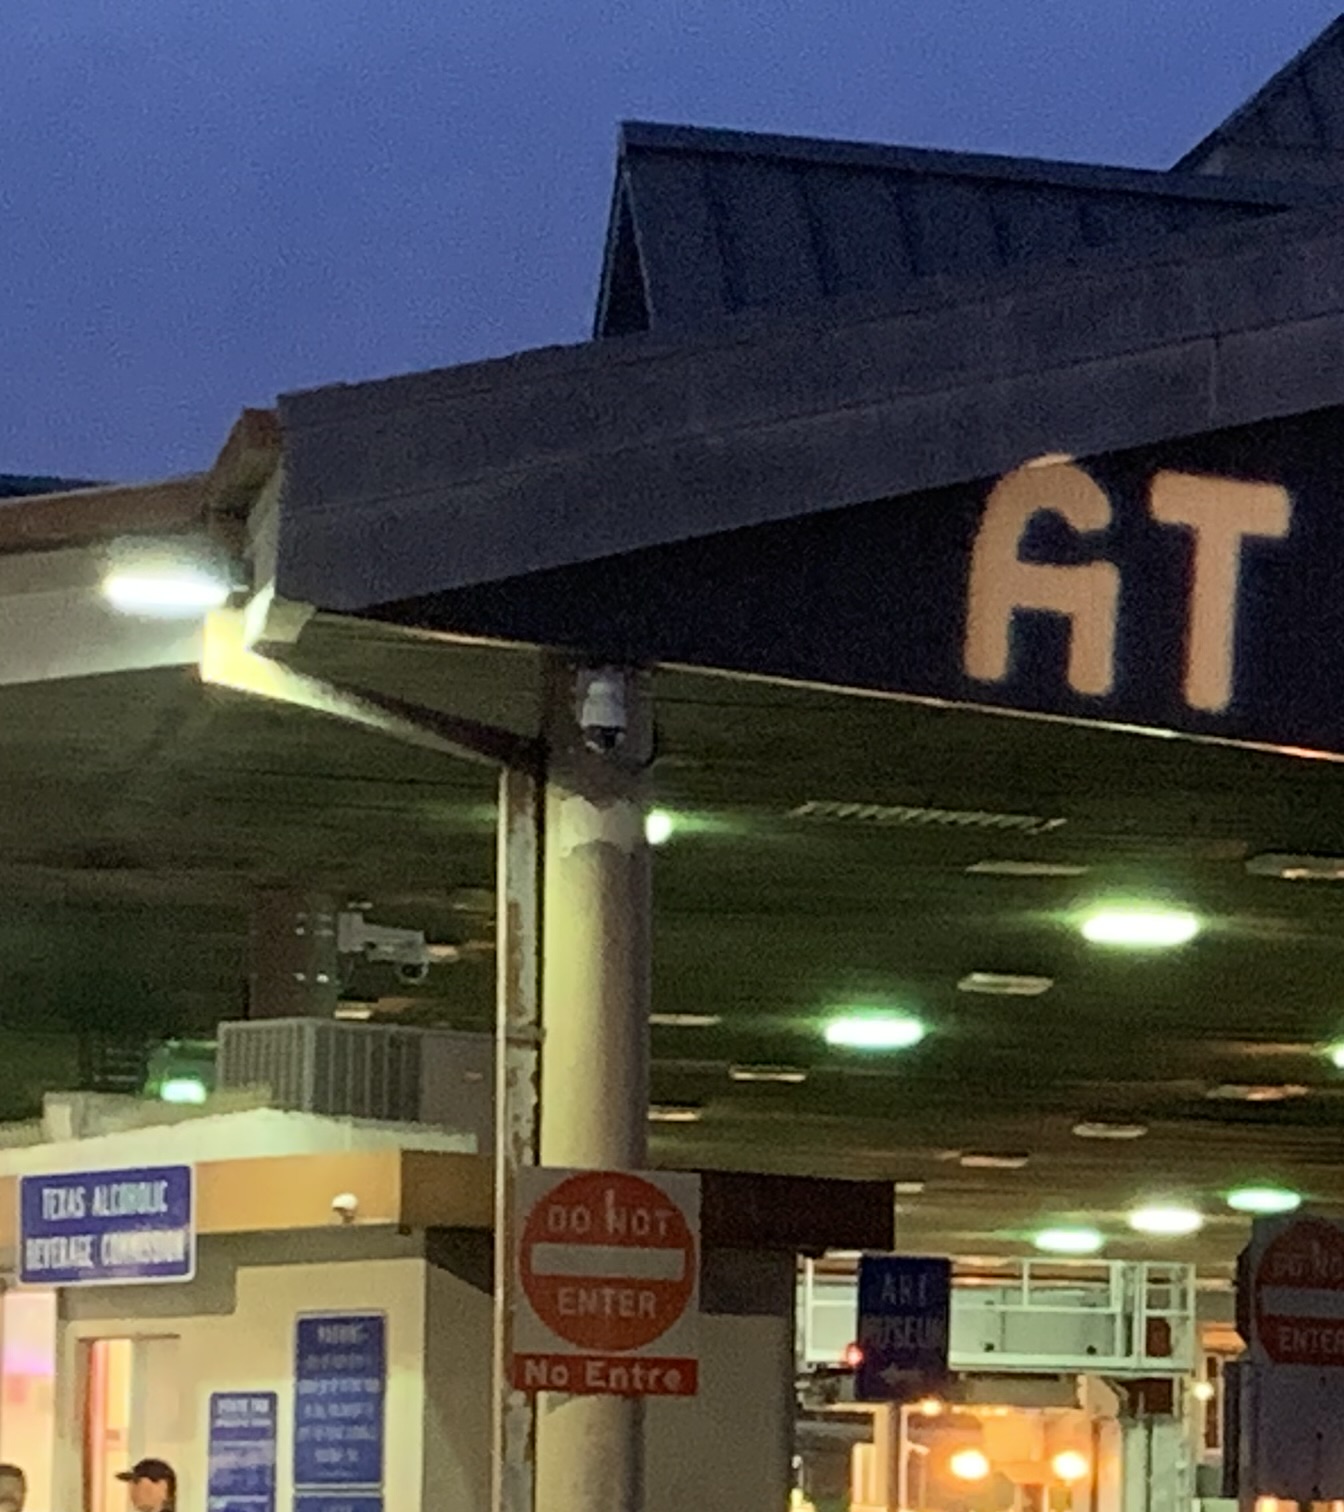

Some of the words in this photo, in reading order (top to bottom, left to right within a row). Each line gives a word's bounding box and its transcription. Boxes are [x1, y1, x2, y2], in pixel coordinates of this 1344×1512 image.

[963, 453, 1292, 714] AT
[42, 1186, 86, 1221] TEXAS
[549, 1204, 592, 1234] DO
[604, 1206, 674, 1236] NOT
[557, 1287, 657, 1319] ENTER
[524, 1358, 569, 1386] No
[584, 1360, 683, 1391] Entre
